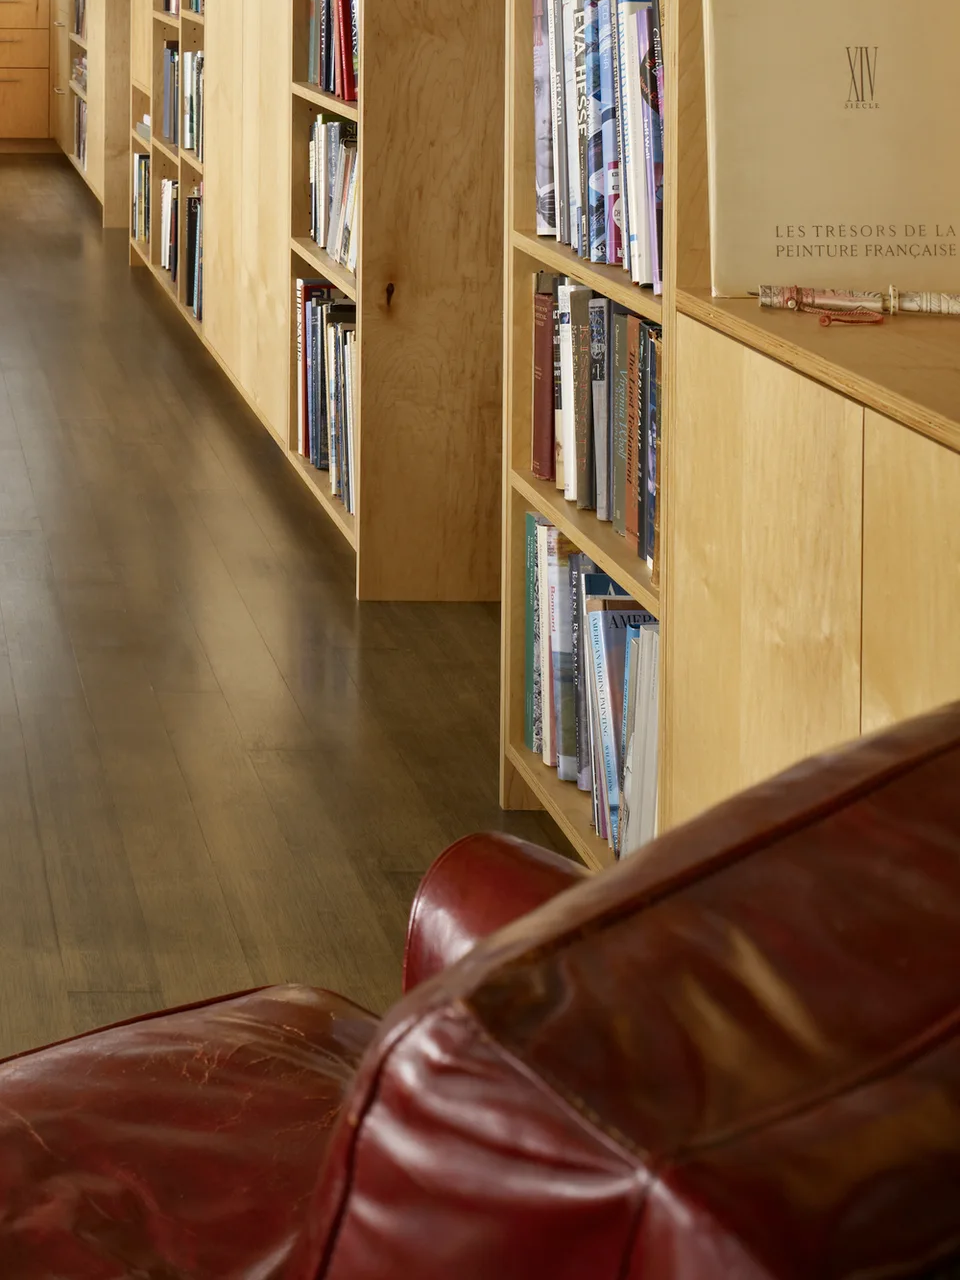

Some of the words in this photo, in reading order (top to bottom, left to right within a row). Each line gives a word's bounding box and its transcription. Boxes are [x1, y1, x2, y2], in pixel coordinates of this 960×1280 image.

[601, 4, 608, 21] ED
[573, 10, 586, 60] EVA
[845, 46, 879, 102] XIV
[575, 66, 587, 137] HESSE
[775, 225, 806, 238] LES
[904, 224, 927, 237] DE
[935, 224, 956, 237] LA
[776, 244, 858, 257] PEINTURE
[865, 243, 957, 259] FRANÇAISE
[628, 352, 636, 378] The
[618, 370, 628, 419] Virginia
[617, 420, 627, 460] Woolf
[626, 412, 635, 484] Testament
[592, 616, 601, 660] AMERICAN
[596, 662, 604, 696] MARINE
[598, 696, 609, 738] PAINTING
[604, 744, 614, 795] WILMERDING
